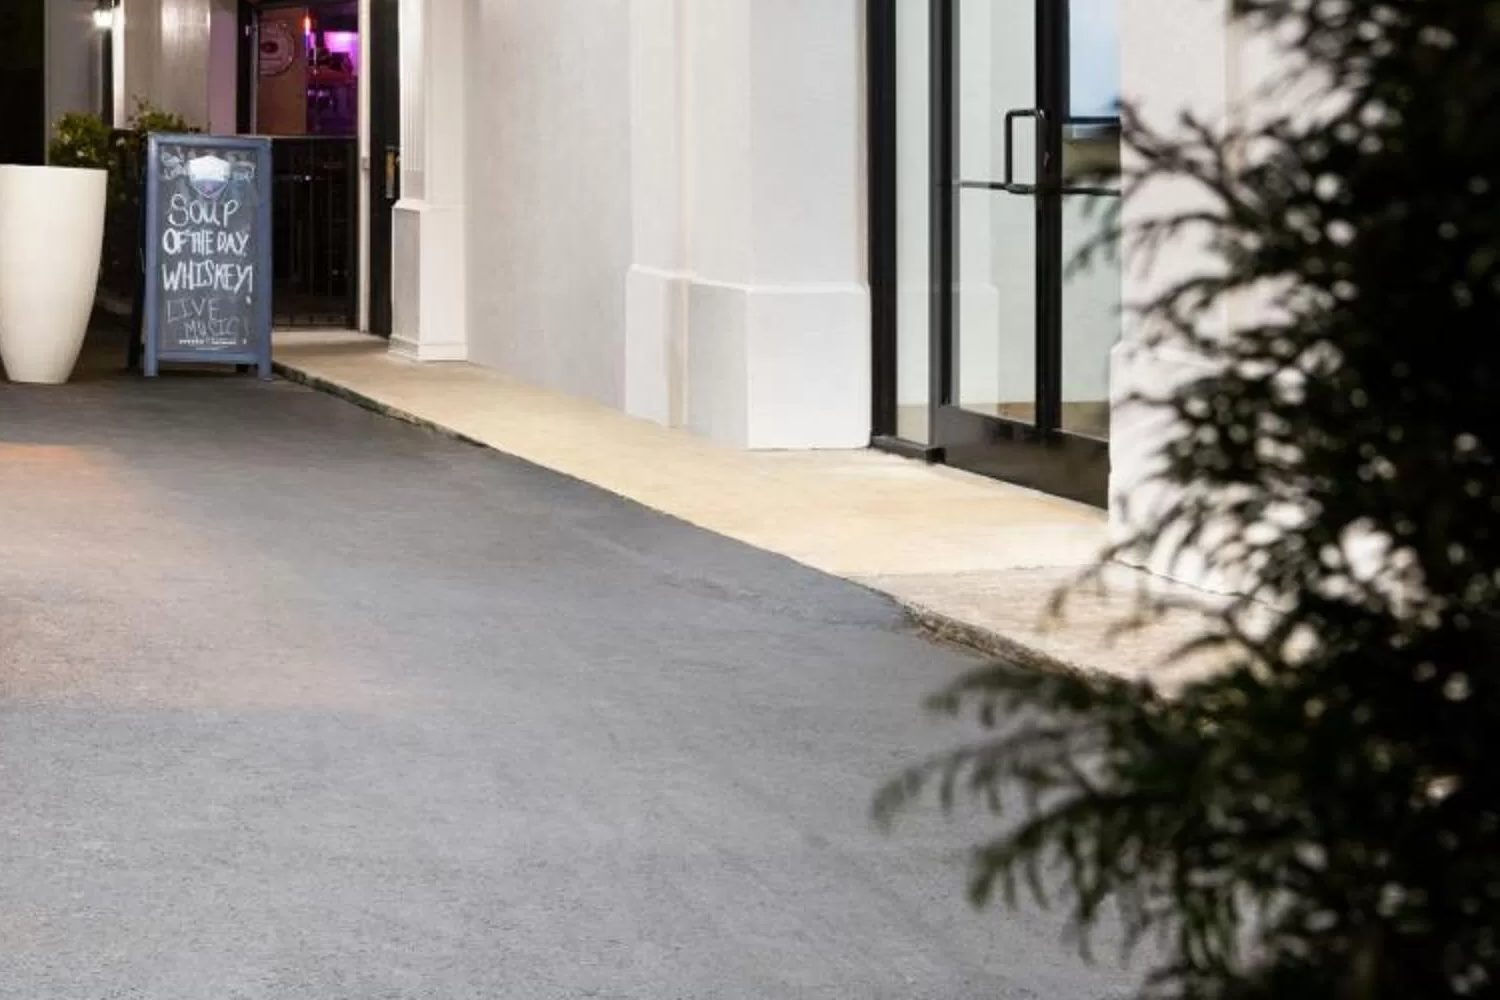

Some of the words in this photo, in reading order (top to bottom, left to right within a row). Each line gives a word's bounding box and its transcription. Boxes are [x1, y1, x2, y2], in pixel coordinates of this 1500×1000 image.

[163, 228, 189, 255] OF
[189, 229, 214, 256] THE
[167, 298, 220, 323] LIVE
